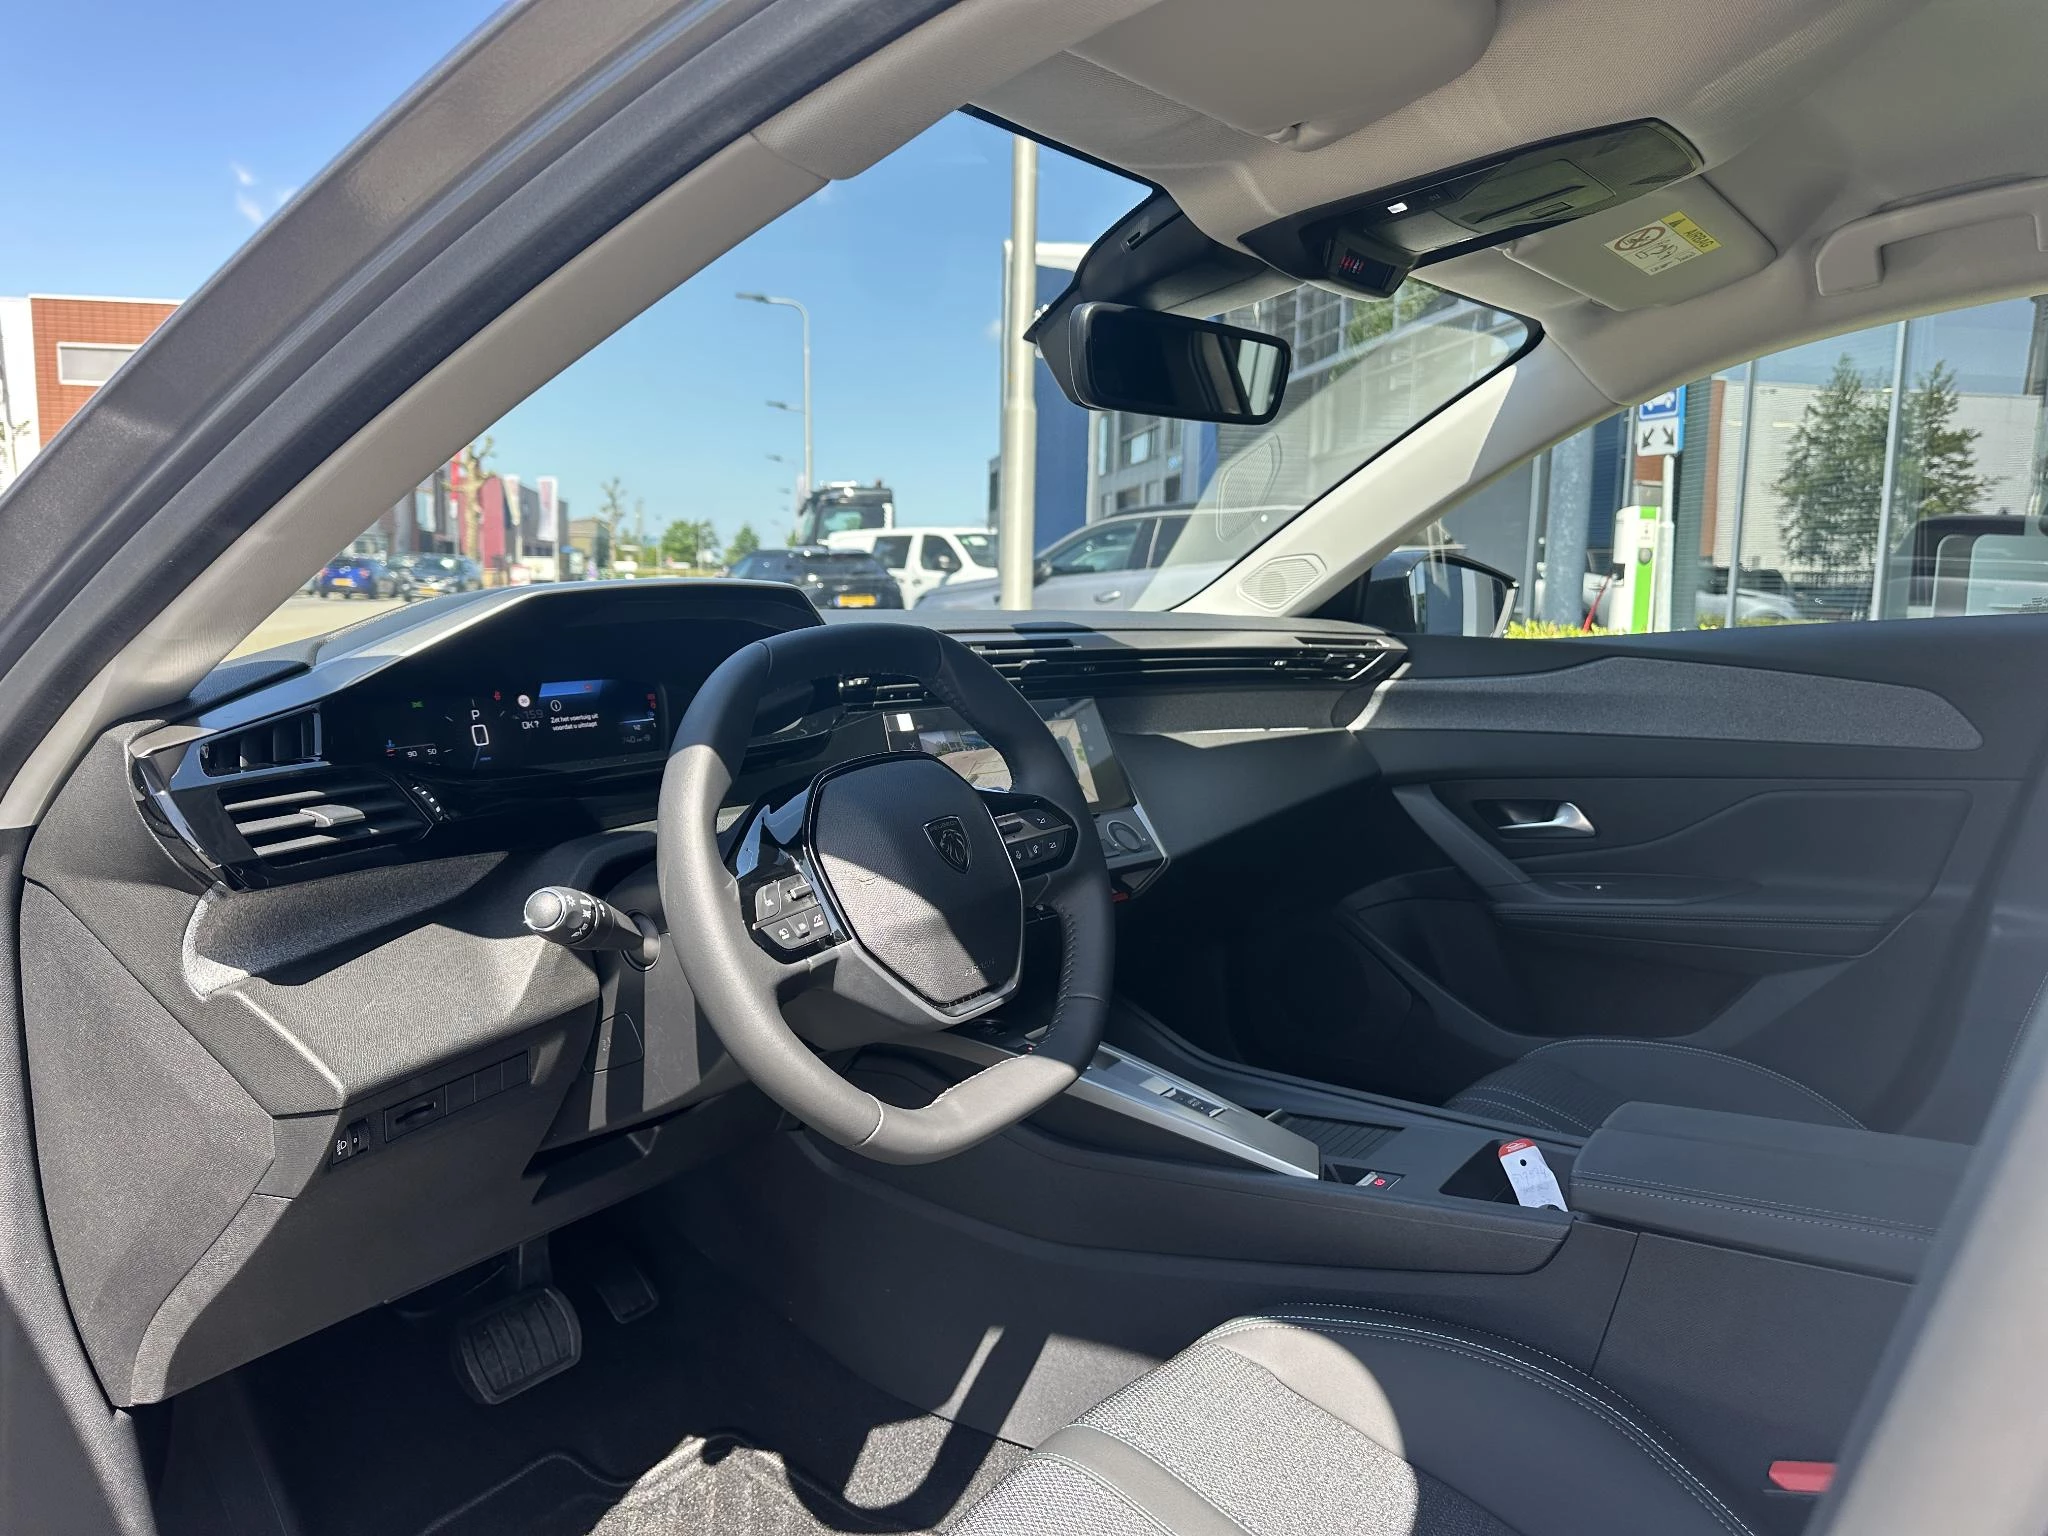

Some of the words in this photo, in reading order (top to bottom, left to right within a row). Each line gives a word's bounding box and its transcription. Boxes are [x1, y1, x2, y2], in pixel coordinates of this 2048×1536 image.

[1684, 228, 1714, 248] AIRBAG
[471, 709, 480, 720] P
[471, 724, 490, 747] 0
[407, 750, 418, 758] 90
[427, 748, 437, 756] 50
